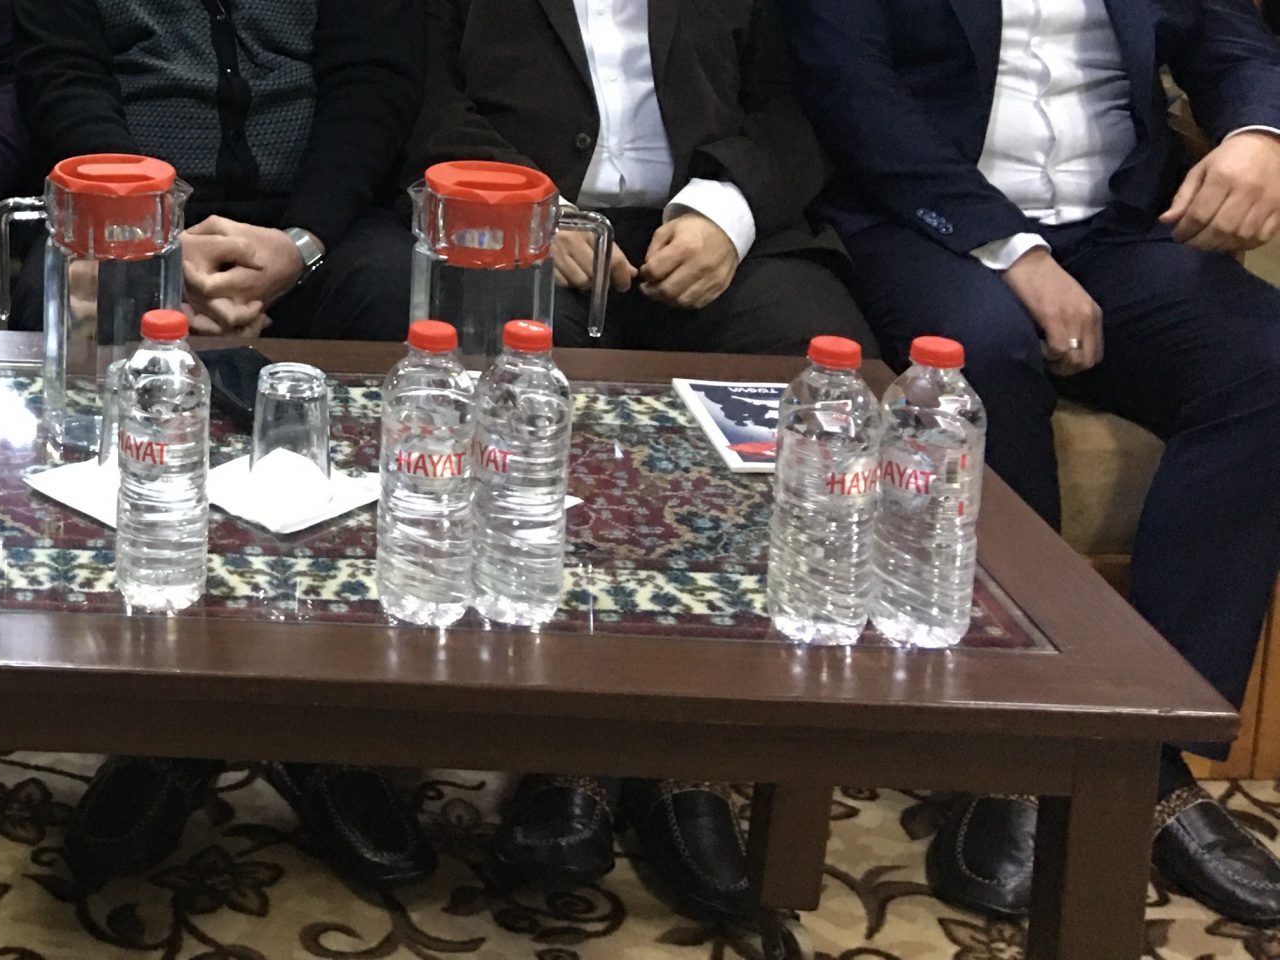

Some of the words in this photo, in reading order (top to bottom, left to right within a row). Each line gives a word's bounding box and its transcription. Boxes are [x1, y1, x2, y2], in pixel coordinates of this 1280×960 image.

[395, 448, 466, 478] HAYAT
[476, 443, 513, 474] YAT
[826, 467, 880, 496] HAYA
